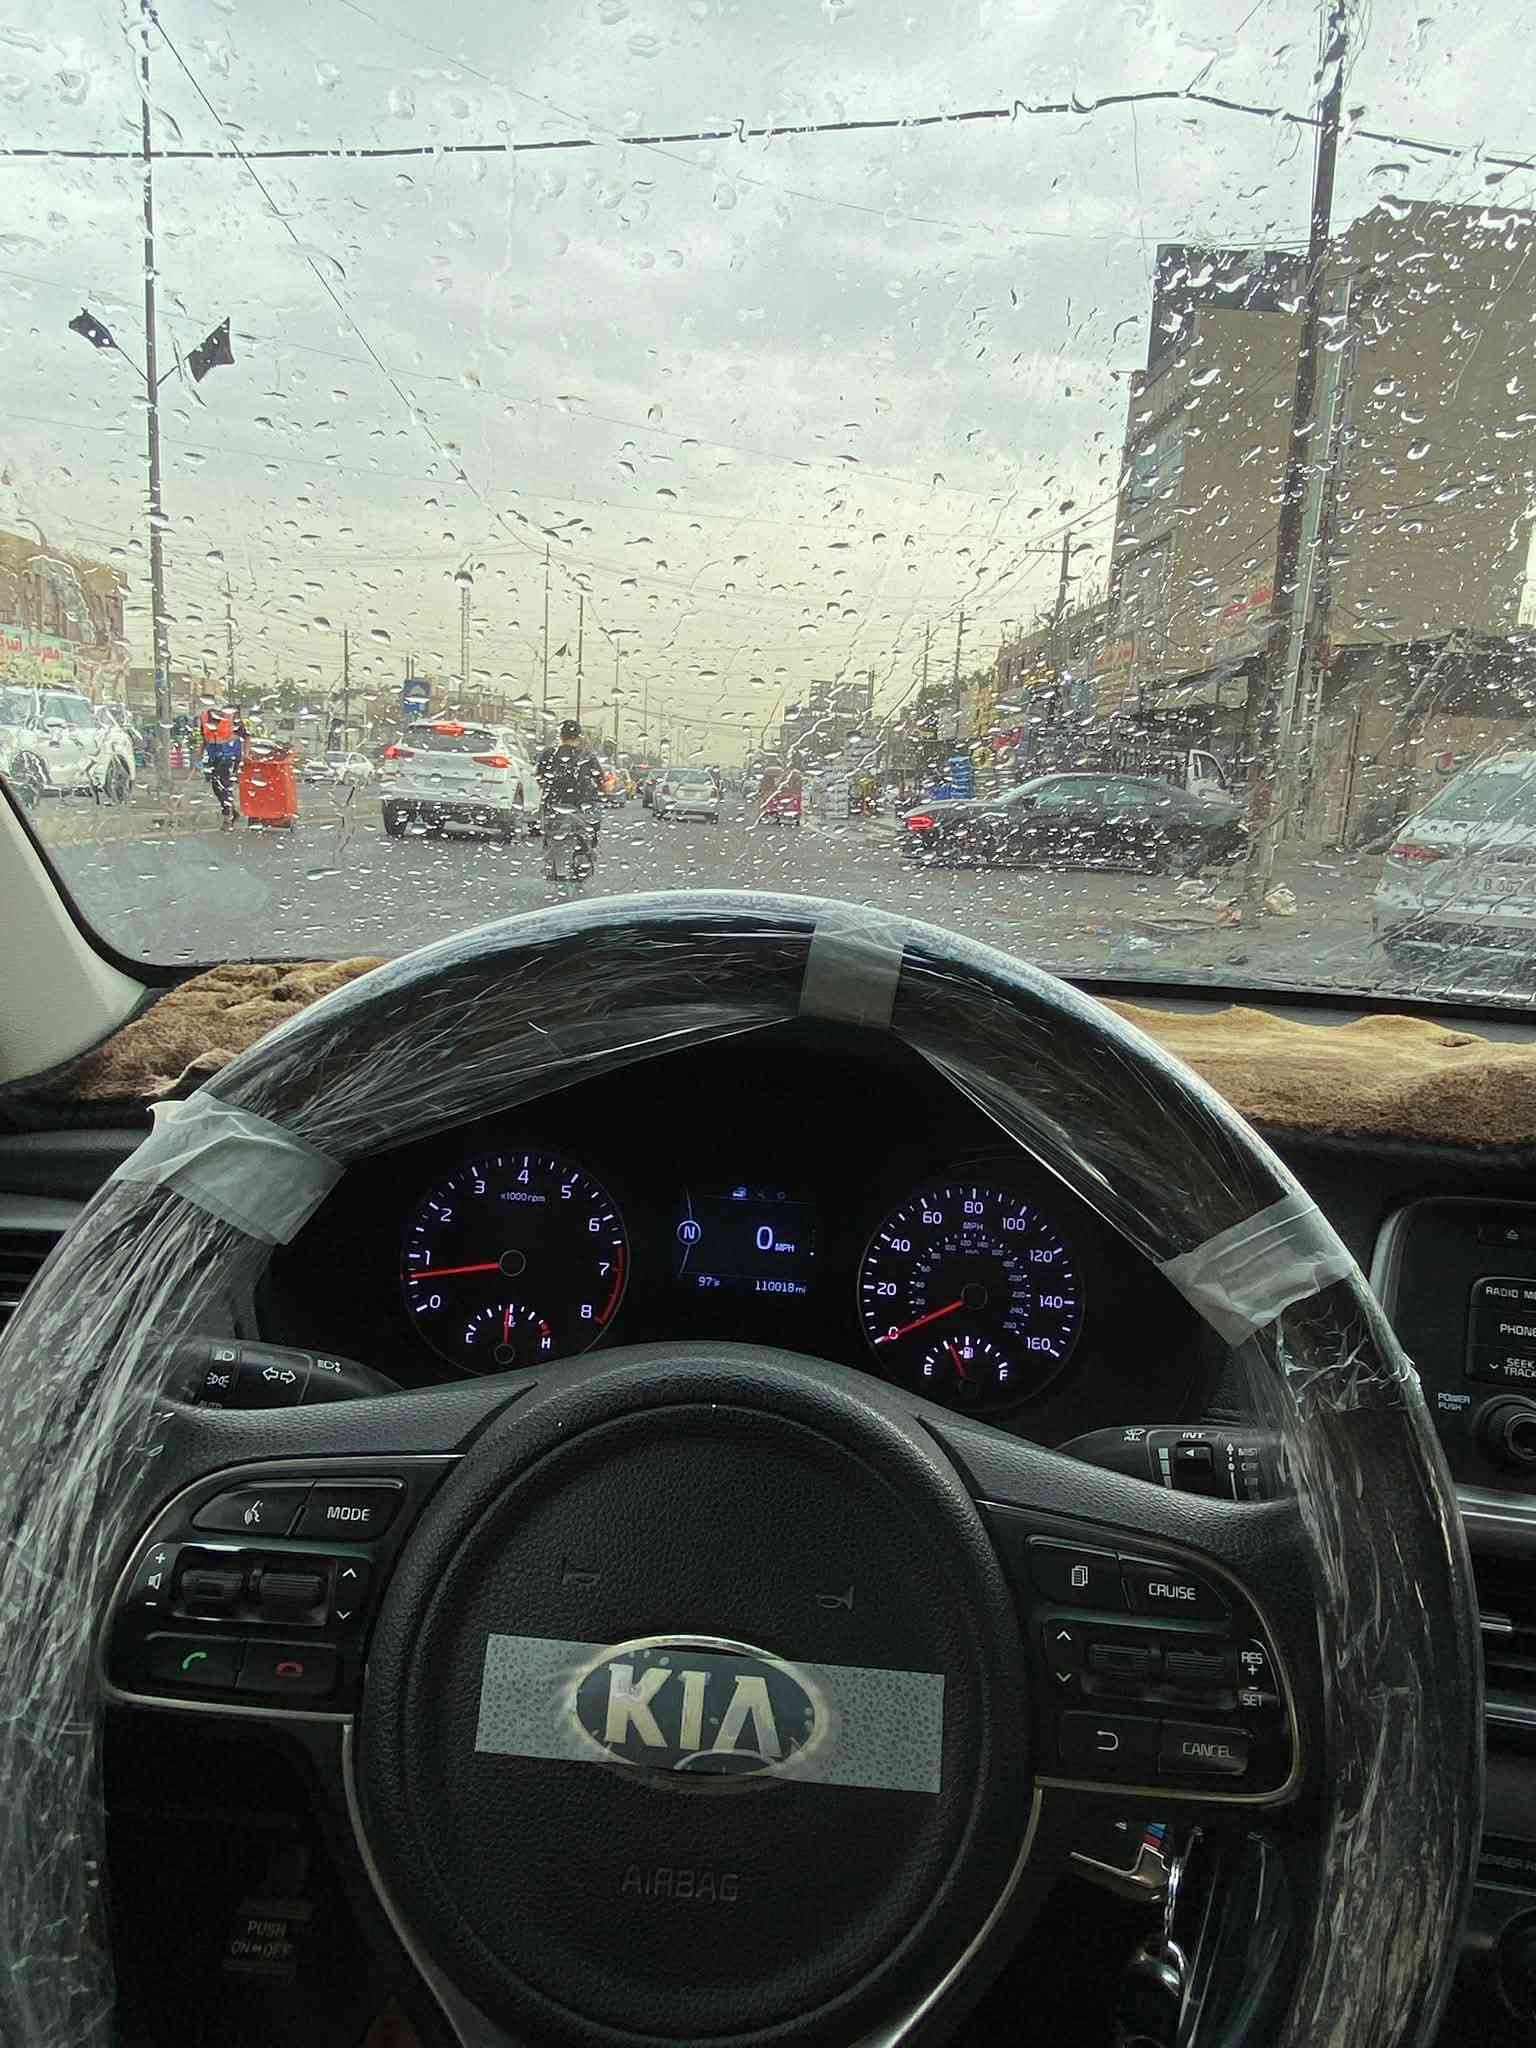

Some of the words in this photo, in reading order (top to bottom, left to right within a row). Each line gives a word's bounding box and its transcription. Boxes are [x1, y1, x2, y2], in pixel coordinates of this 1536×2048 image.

[518, 1169, 529, 1184] 4
[475, 1181, 486, 1194] 3
[561, 1185, 571, 1199] 5
[441, 1208, 452, 1222] 2
[964, 1202, 983, 1214] 80
[922, 1211, 942, 1224] 60
[1002, 1217, 1025, 1231] 100
[589, 1218, 600, 1232] 6
[963, 1222, 984, 1231] MPH
[684, 1226, 695, 1240] N
[756, 1226, 773, 1250] 0
[891, 1239, 910, 1251] 40
[424, 1250, 431, 1265] 1
[1030, 1250, 1053, 1263] 120
[600, 1262, 610, 1276] 7
[877, 1283, 896, 1296] 20
[1486, 1286, 1519, 1298] RADIO
[430, 1294, 441, 1308] 0
[1039, 1295, 1063, 1309] 140
[581, 1304, 592, 1319] 8
[541, 1337, 551, 1350] H
[1027, 1336, 1051, 1350] 160
[923, 1365, 932, 1376] E
[1506, 1358, 1535, 1369] SEEK
[999, 1369, 1008, 1381] F
[327, 1506, 371, 1521] MODE
[1148, 1583, 1196, 1600] CRUISE
[1241, 1652, 1263, 1664] RES
[1242, 1694, 1263, 1706] SET
[605, 1663, 785, 1758] KIA
[1182, 1741, 1232, 1758] CANCEL
[621, 1865, 739, 1901] AIRBAG
